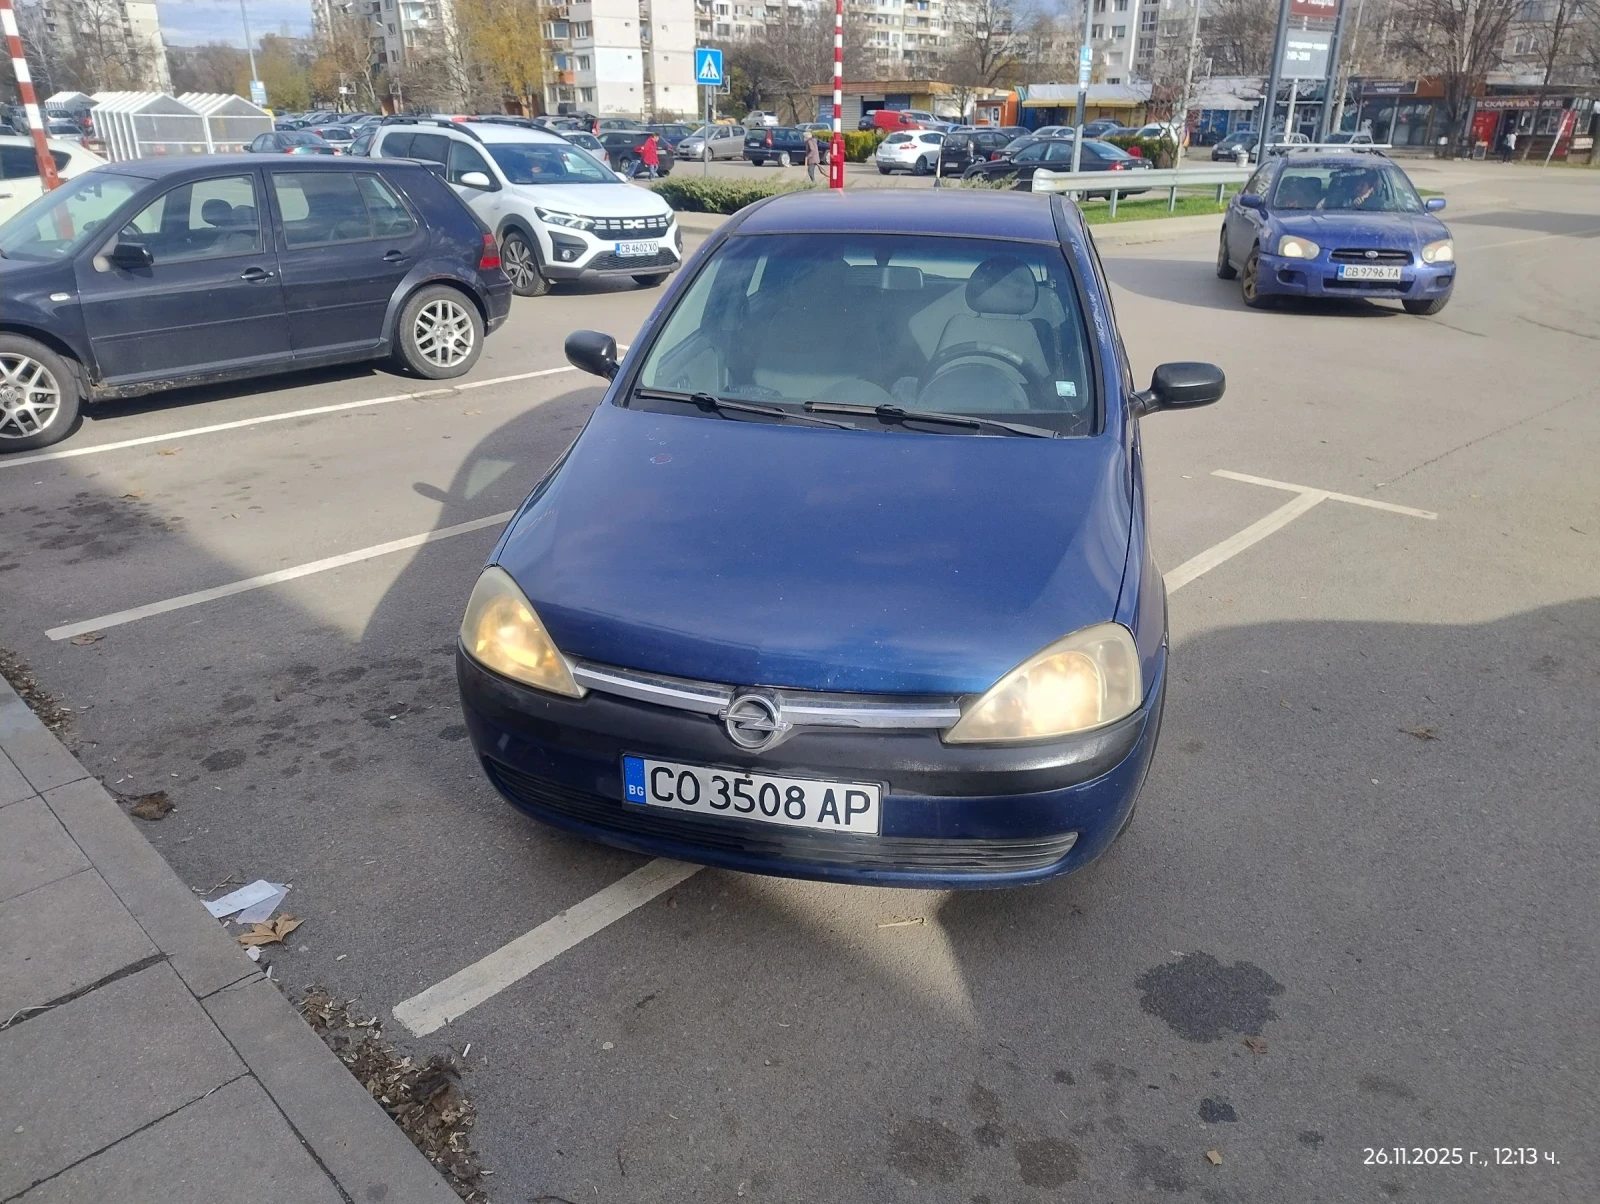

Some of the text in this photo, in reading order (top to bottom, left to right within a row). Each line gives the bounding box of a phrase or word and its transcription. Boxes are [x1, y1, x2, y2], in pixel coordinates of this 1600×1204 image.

[1484, 100, 1513, 108] СКАРА
[631, 243, 648, 253] 4602
[1345, 267, 1399, 277] CB 9796 TA
[628, 766, 871, 826] BG CO 3508 AP
